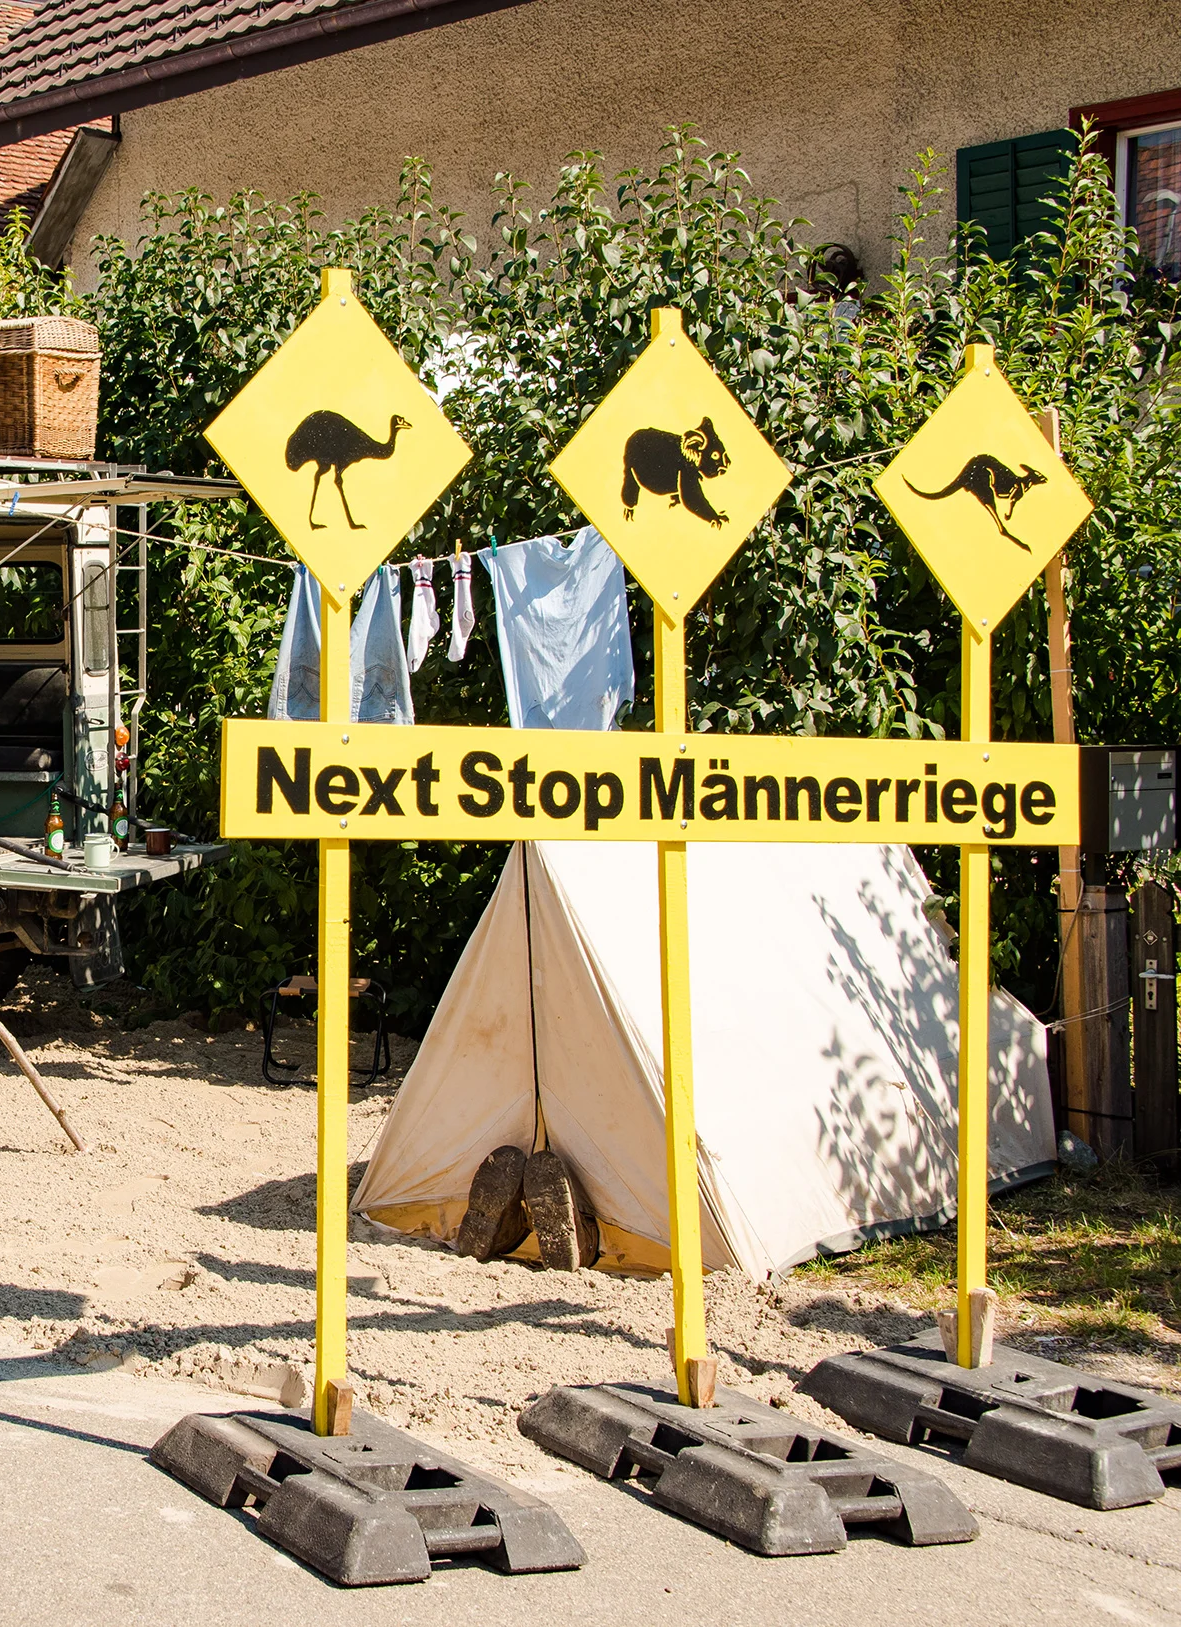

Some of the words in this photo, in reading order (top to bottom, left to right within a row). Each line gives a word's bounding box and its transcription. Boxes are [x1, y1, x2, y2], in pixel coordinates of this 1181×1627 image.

[256, 746, 440, 816] Next
[457, 750, 625, 831] Stop
[639, 757, 1056, 839] Männerriege
